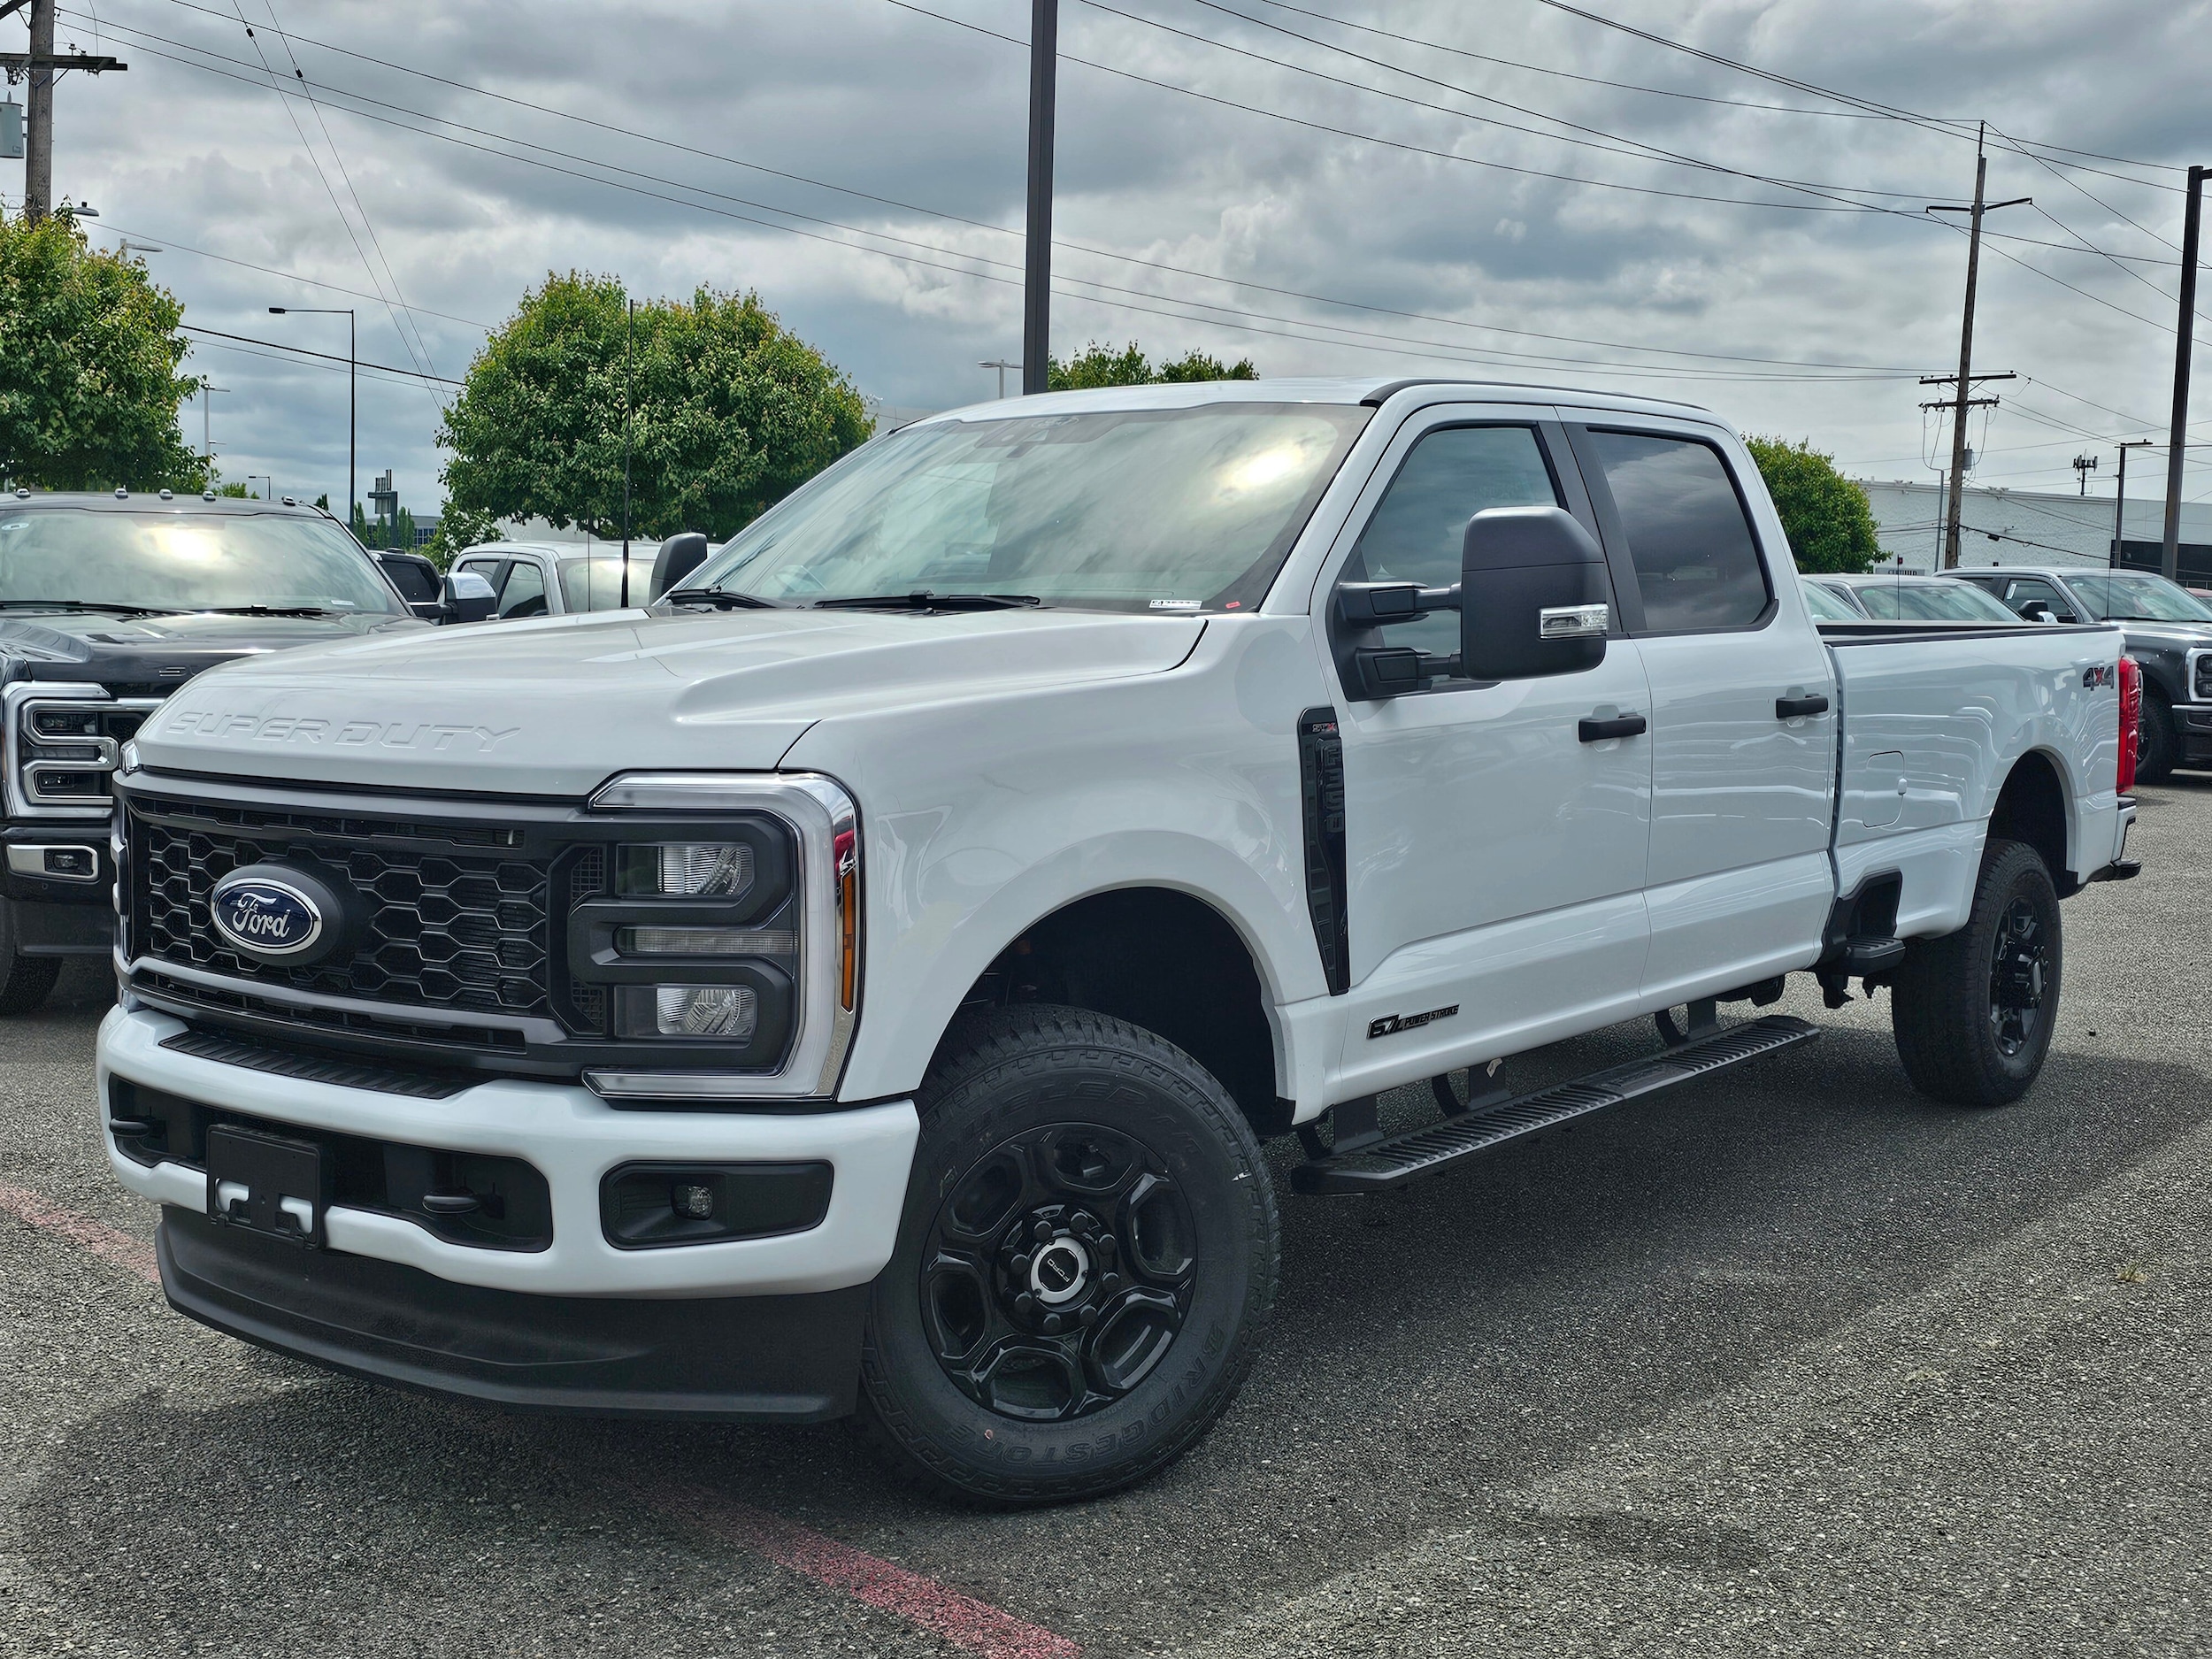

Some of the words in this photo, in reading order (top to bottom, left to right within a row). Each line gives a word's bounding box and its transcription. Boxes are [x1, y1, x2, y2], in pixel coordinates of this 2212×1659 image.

[165, 711, 331, 744] SUPER
[334, 720, 522, 753] DUTY
[1312, 722, 1336, 733] STX
[231, 892, 290, 938] Ford
[1047, 1258, 1070, 1283] FORD
